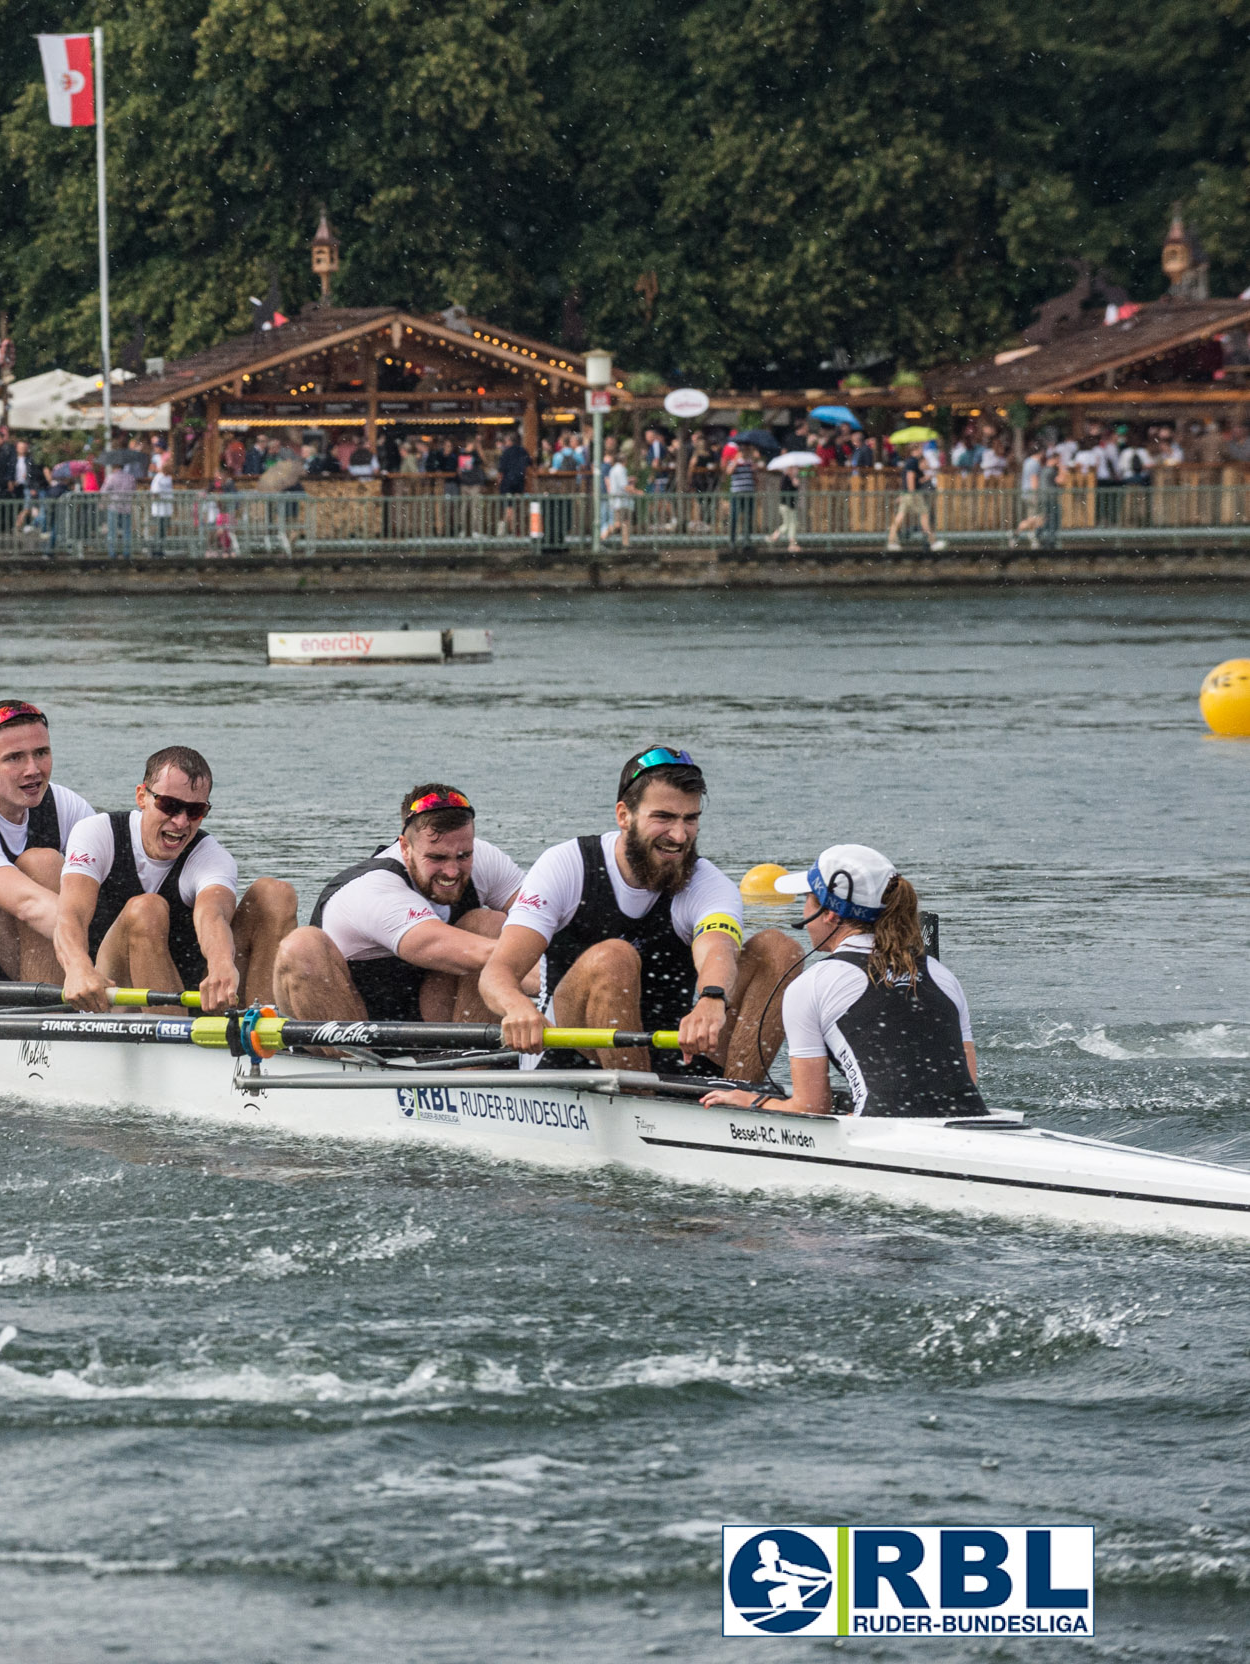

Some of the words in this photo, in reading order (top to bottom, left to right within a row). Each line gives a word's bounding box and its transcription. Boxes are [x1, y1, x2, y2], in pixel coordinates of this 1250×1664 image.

[301, 632, 374, 655] enercity
[41, 1020, 77, 1032] STARK.
[78, 1021, 127, 1034] SCHNELL.
[128, 1023, 153, 1036] GUT.
[160, 1023, 189, 1036] RBL
[417, 1087, 458, 1114] RBL
[460, 1091, 590, 1131] RUDER-BUNDESLIGA
[730, 1122, 779, 1144] Bessel-R.C.
[781, 1128, 816, 1149] Minden
